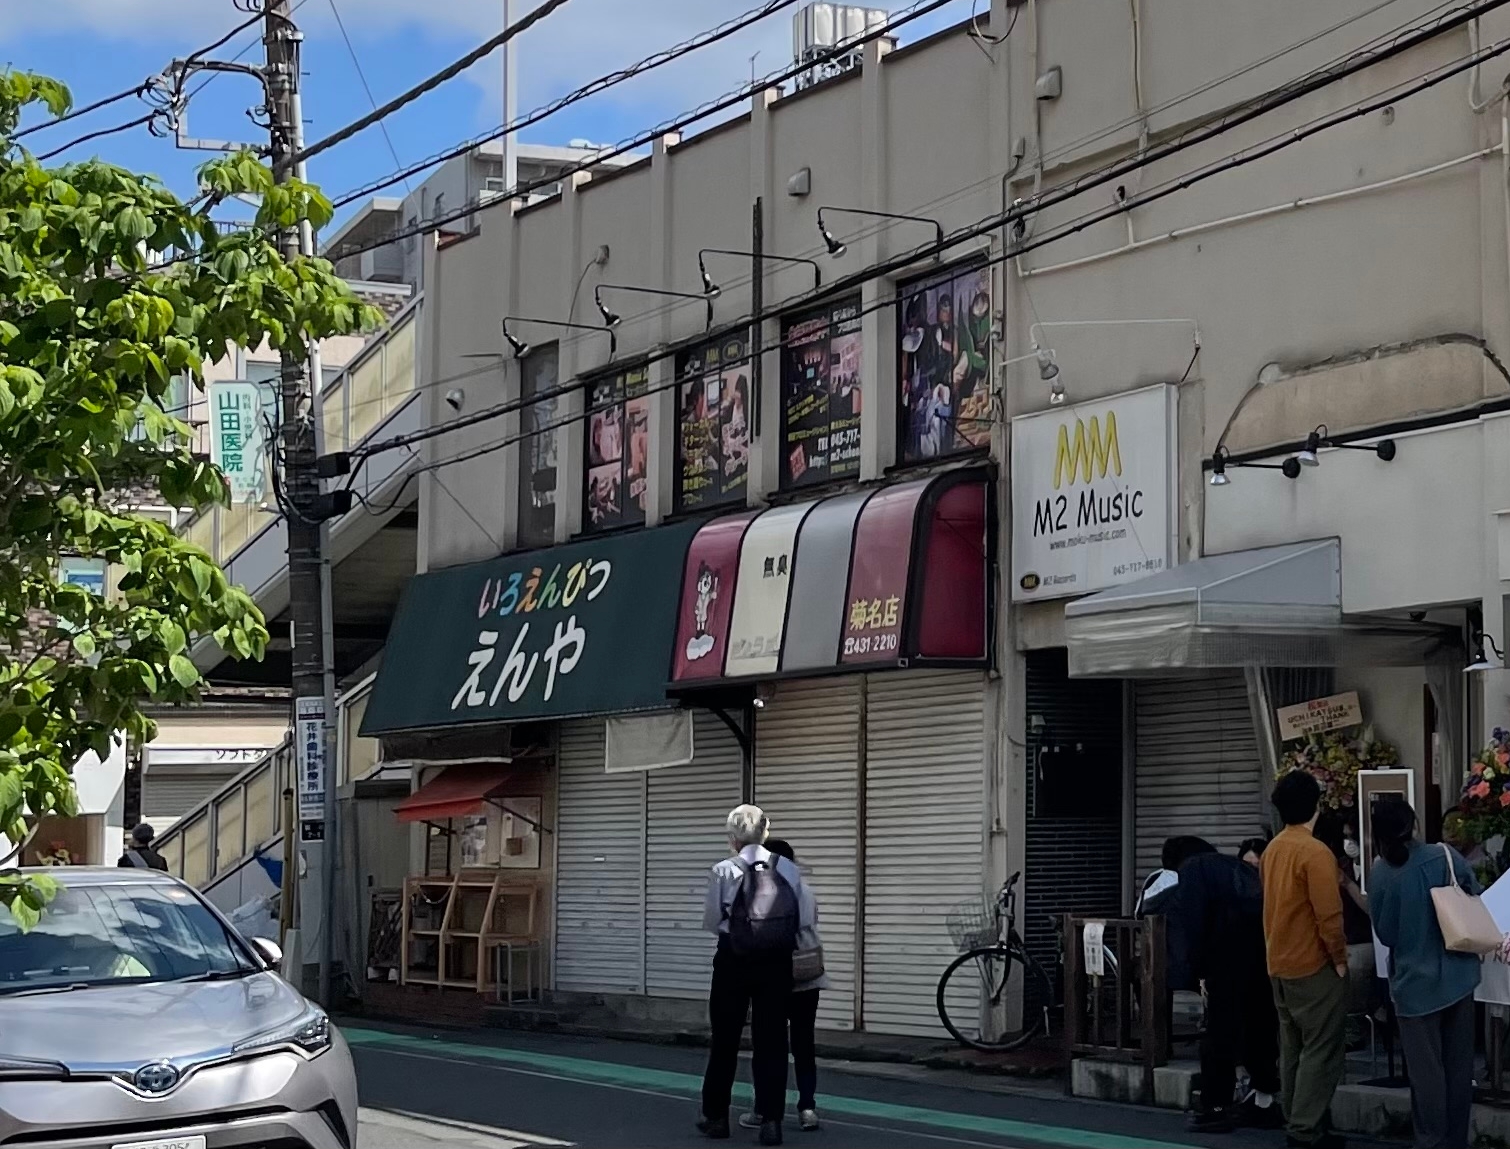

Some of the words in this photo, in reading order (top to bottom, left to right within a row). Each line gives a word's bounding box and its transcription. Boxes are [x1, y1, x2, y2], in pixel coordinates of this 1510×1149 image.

[218, 391, 243, 472] 山田医院
[1033, 494, 1068, 538] M2
[1077, 485, 1144, 528] Music
[478, 558, 612, 619] いろえんぴつ
[850, 595, 900, 630] 菊名店
[451, 615, 586, 710] えんや
